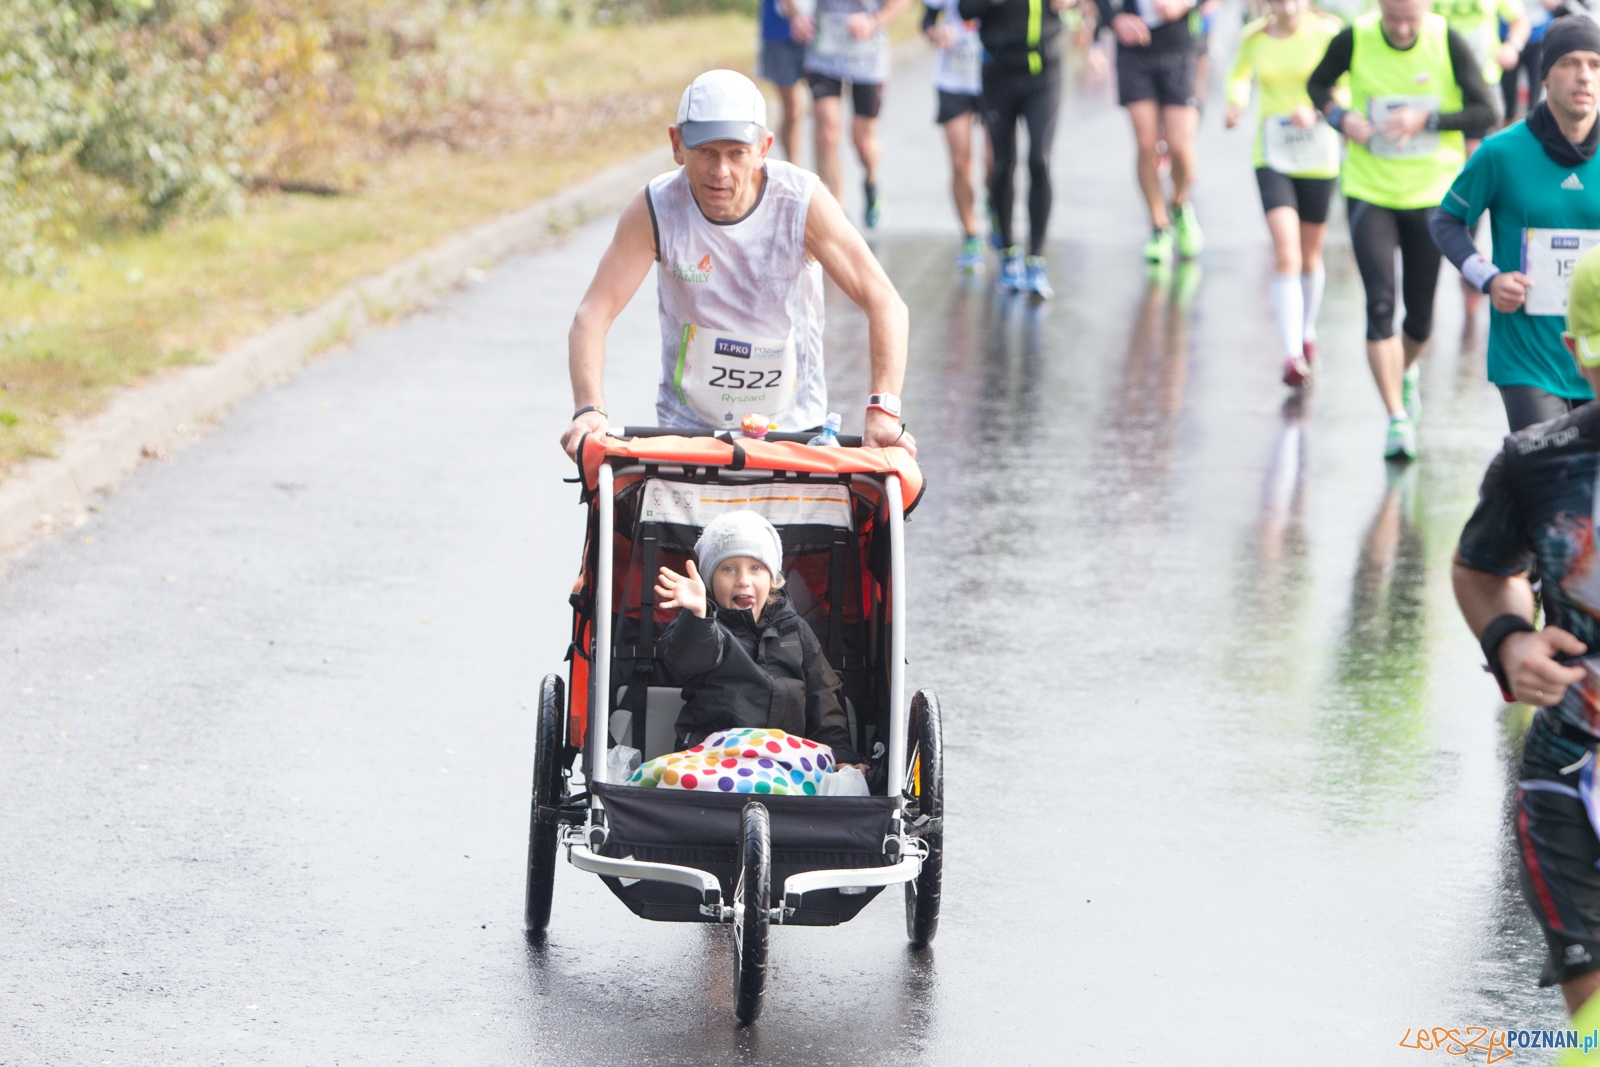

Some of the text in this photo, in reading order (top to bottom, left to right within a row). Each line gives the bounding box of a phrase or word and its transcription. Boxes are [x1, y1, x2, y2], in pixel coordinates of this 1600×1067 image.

[673, 270, 710, 283] FAMILY
[709, 366, 782, 389] 2522
[721, 393, 766, 404] Ryszard
